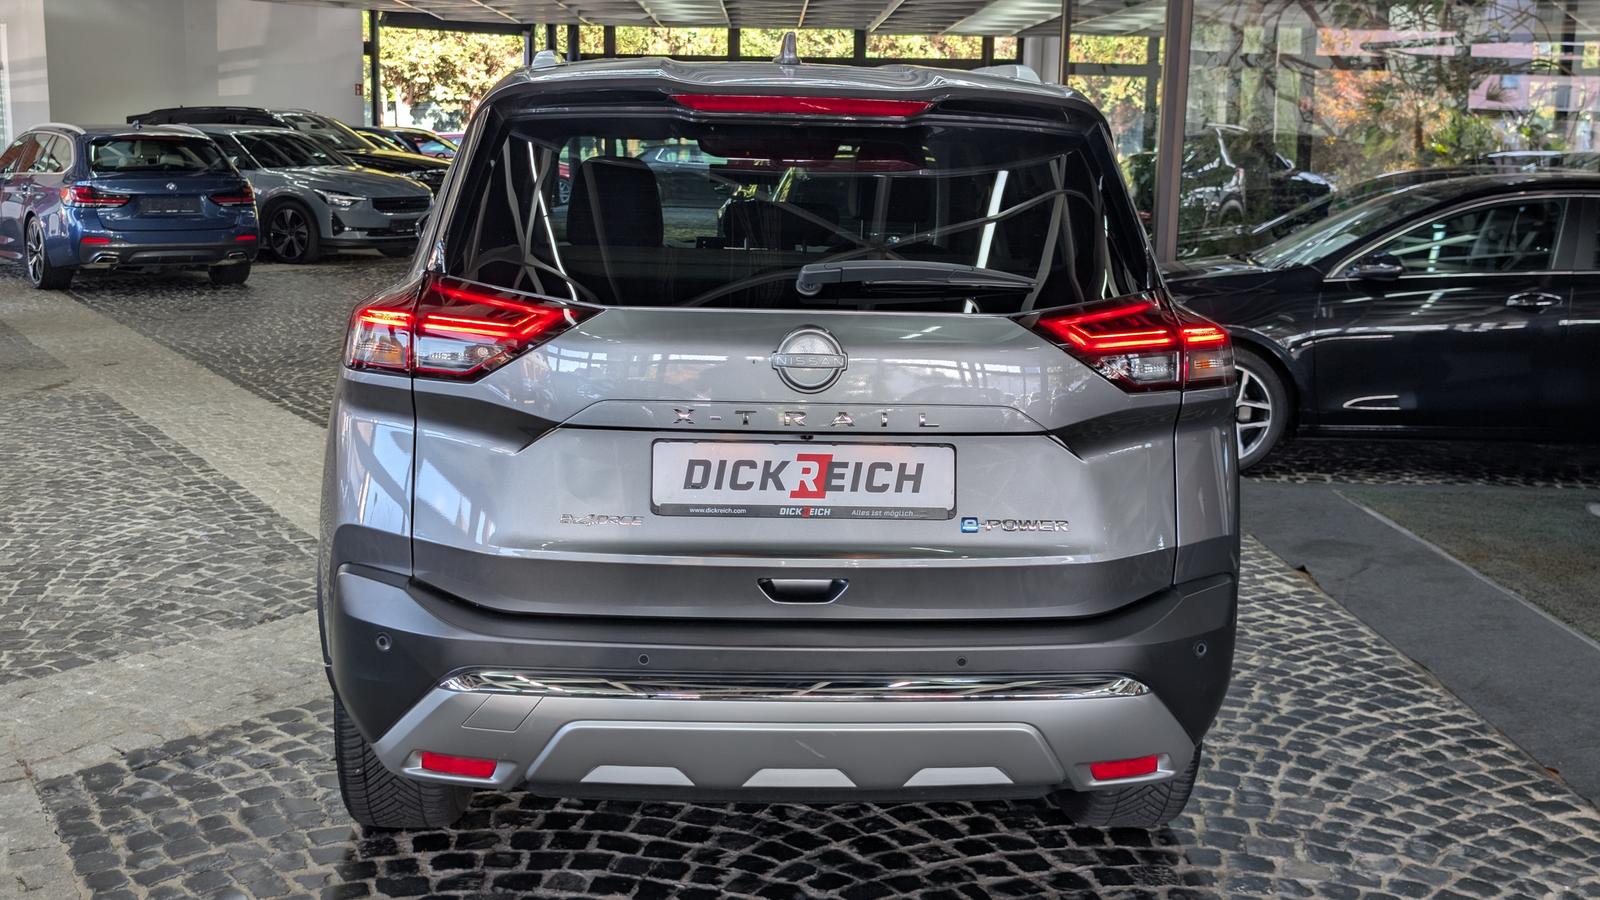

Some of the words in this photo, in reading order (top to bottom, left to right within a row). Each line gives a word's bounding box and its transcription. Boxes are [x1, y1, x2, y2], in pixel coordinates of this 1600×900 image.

[776, 356, 844, 366] NISSAN
[672, 408, 940, 428] X-TRAIL
[683, 453, 924, 499] DICKREICH
[851, 509, 870, 517] Alles
[961, 517, 1070, 533] e-POWER
